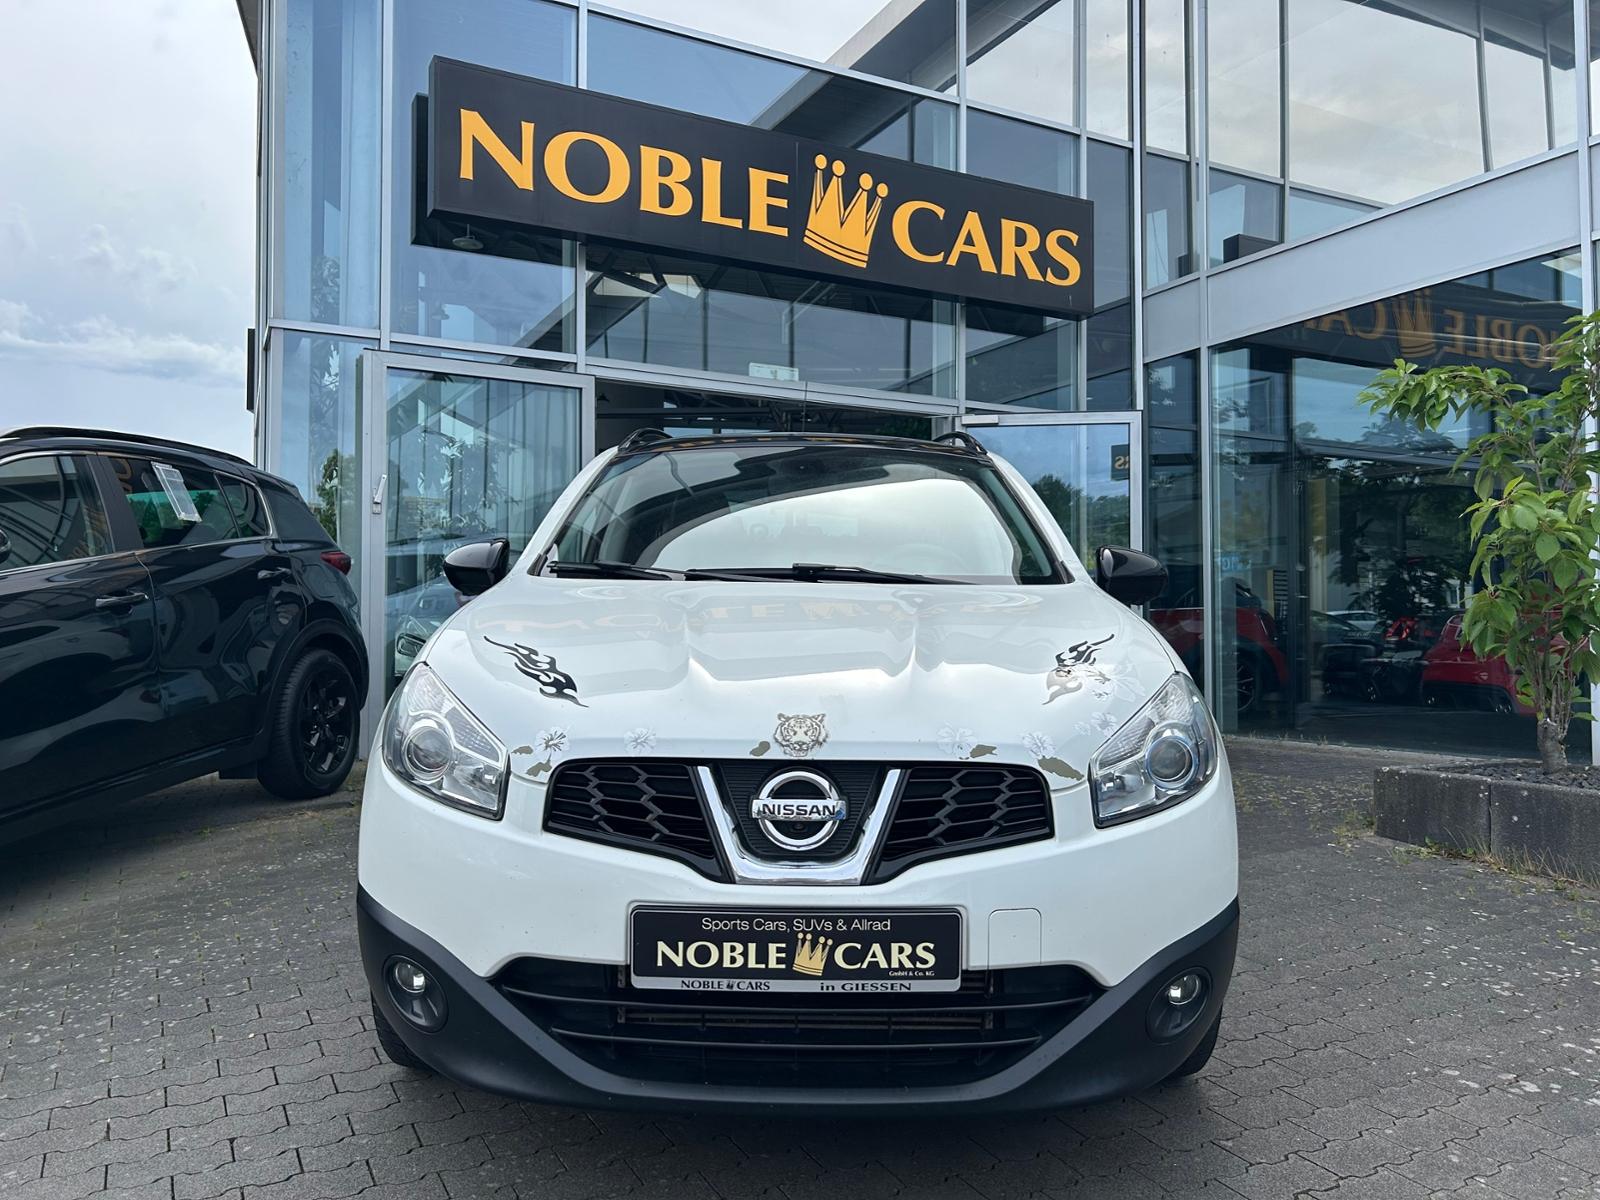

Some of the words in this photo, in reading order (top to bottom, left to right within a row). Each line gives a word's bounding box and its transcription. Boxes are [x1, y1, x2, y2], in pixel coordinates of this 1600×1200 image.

[459, 107, 790, 237] NOBLE
[891, 199, 1082, 287] CARS
[762, 803, 836, 816] NISSAN
[701, 917, 750, 932] Sports
[753, 918, 790, 933] Cars,
[793, 918, 833, 931] SUVs
[836, 918, 848, 931] &
[850, 918, 891, 931] Allrad
[656, 940, 787, 969] NOBLE
[834, 942, 936, 970] CARS
[681, 979, 724, 990] NOBLE
[736, 981, 771, 991] CARS
[820, 982, 835, 991] in
[841, 982, 912, 992] GIESSEN
